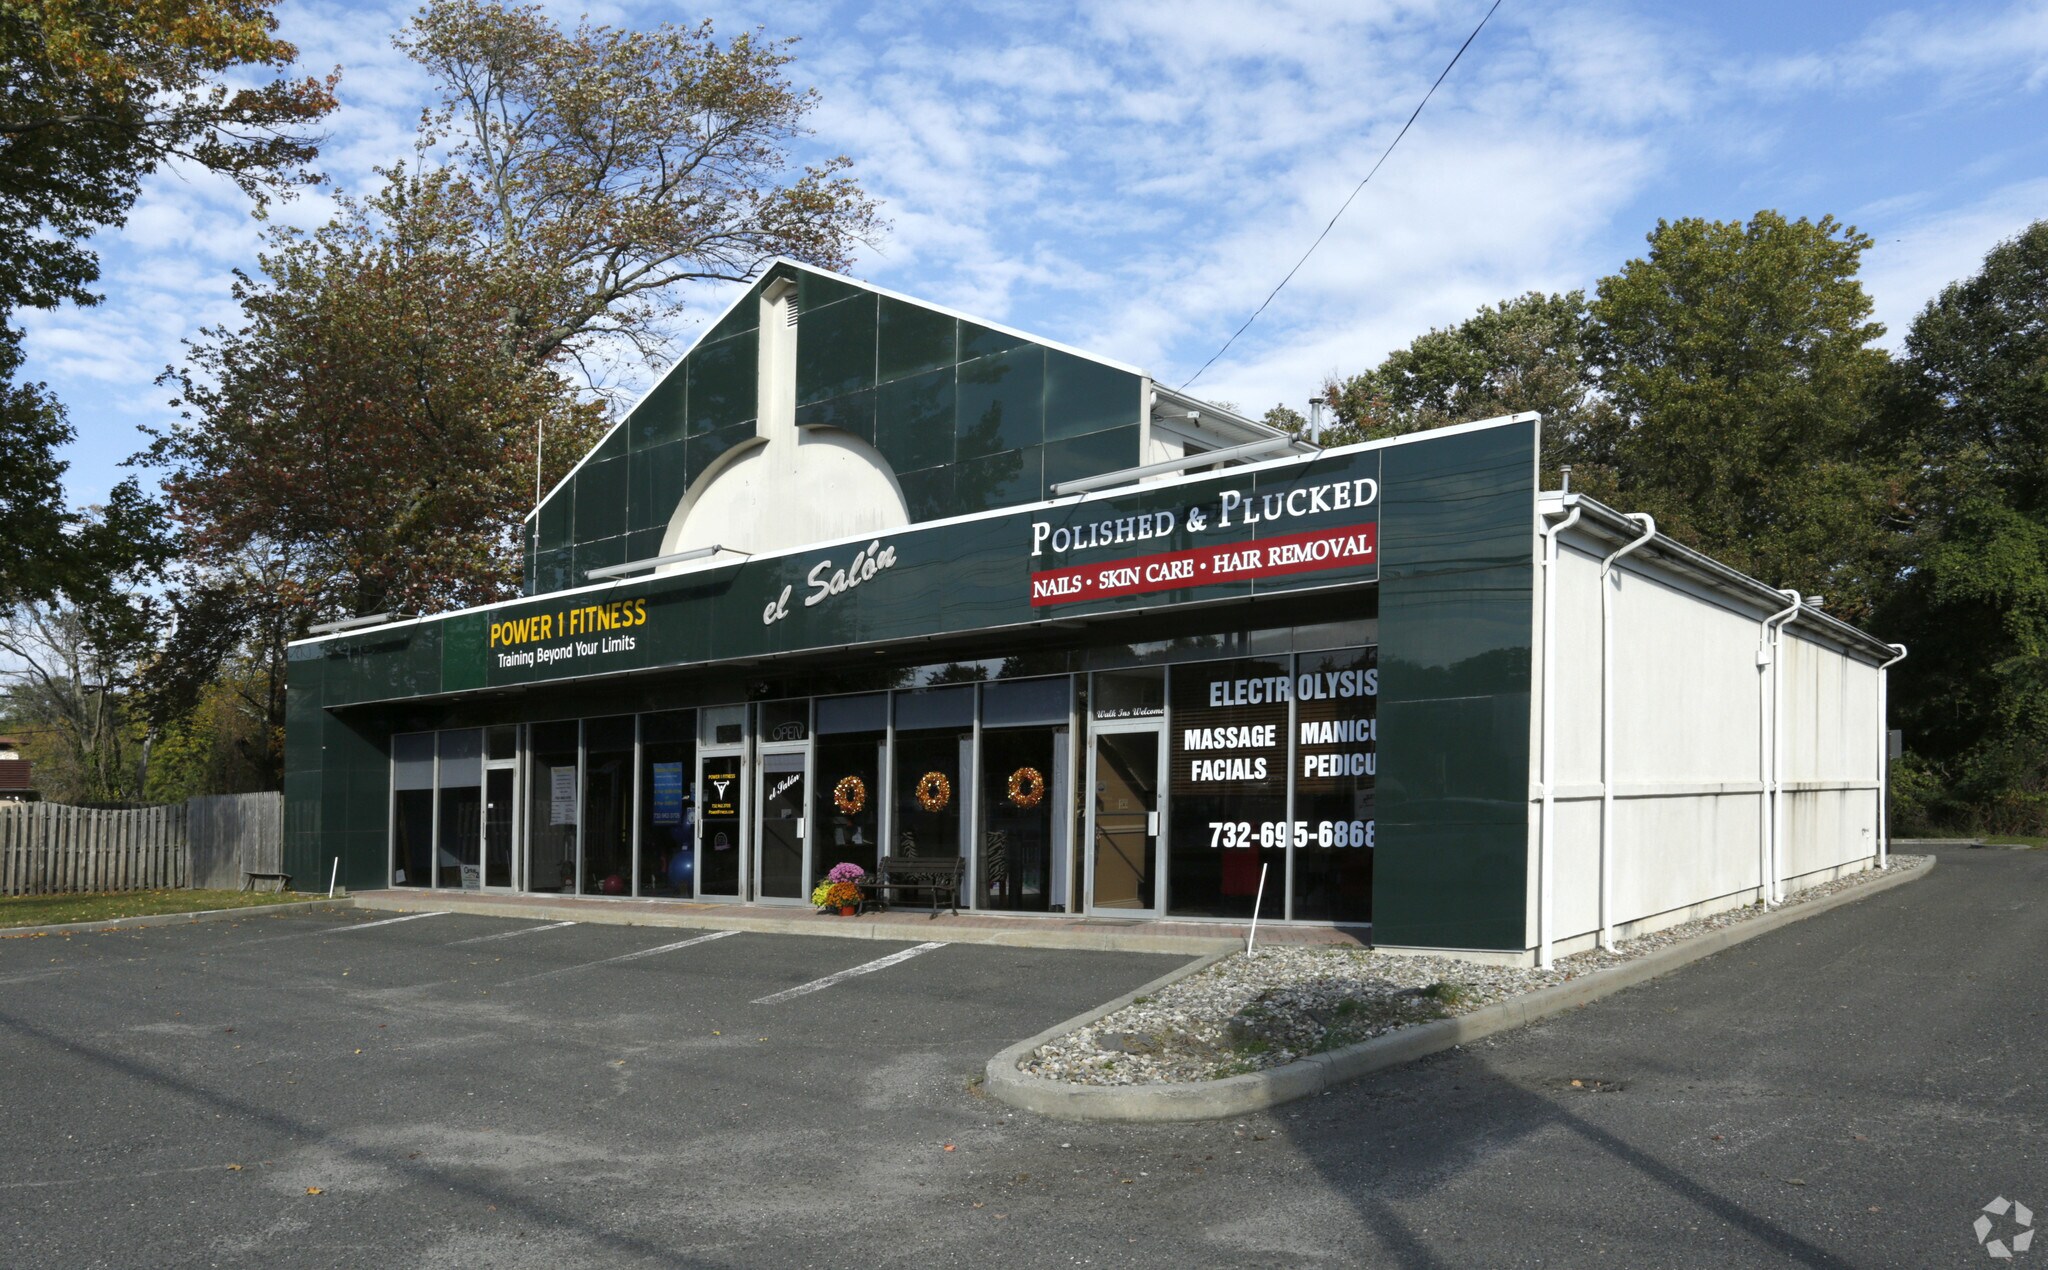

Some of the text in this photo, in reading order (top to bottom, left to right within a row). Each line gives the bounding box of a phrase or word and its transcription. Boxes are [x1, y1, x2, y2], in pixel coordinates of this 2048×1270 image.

[1186, 506, 1206, 532] &
[1033, 534, 1372, 598] NAILS SKIN CARE HAIR REMOVAL
[763, 540, 897, 626] el Salón
[491, 598, 647, 648] POWER 1 FITNESS
[498, 635, 635, 669] Training Beyond Your Limits
[1097, 707, 1164, 718] Walk Ins Welcome
[773, 726, 802, 741] OPEN
[1184, 725, 1276, 750] MASSAGE
[1191, 757, 1267, 782] FACIALS
